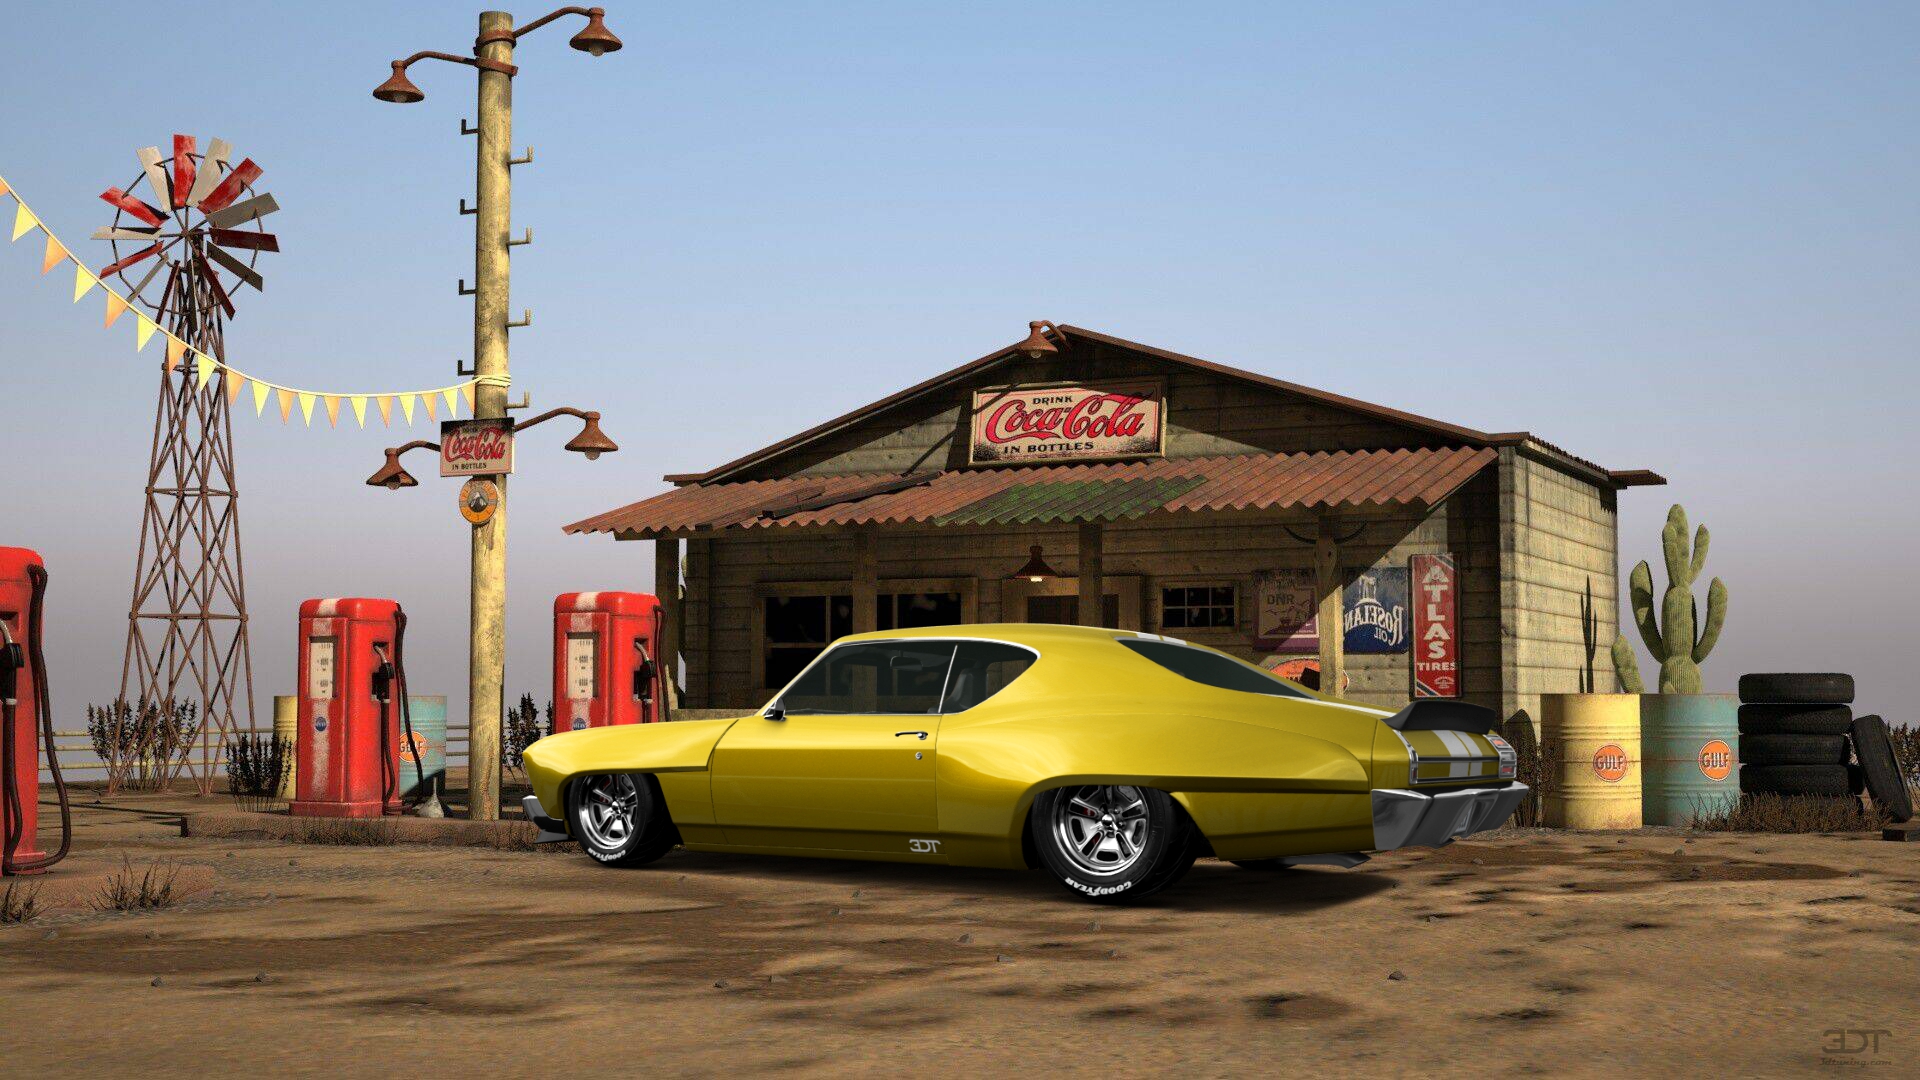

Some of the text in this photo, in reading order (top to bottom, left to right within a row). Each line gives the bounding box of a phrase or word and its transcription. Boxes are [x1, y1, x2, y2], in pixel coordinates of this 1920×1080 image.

[1032, 395, 1073, 405] DRINK
[985, 393, 1151, 444] Coca-Cola
[445, 427, 506, 462] Coca-Cola
[1004, 441, 1094, 454] IN BOTTLES
[461, 462, 487, 471] BOTTLES
[1422, 565, 1450, 660] ATLAS
[1416, 660, 1456, 671] TIRES
[1595, 754, 1624, 772] GULF
[1701, 752, 1729, 768] GULF
[909, 839, 941, 853] 3DT
[1065, 877, 1132, 896] GOODYEAR
